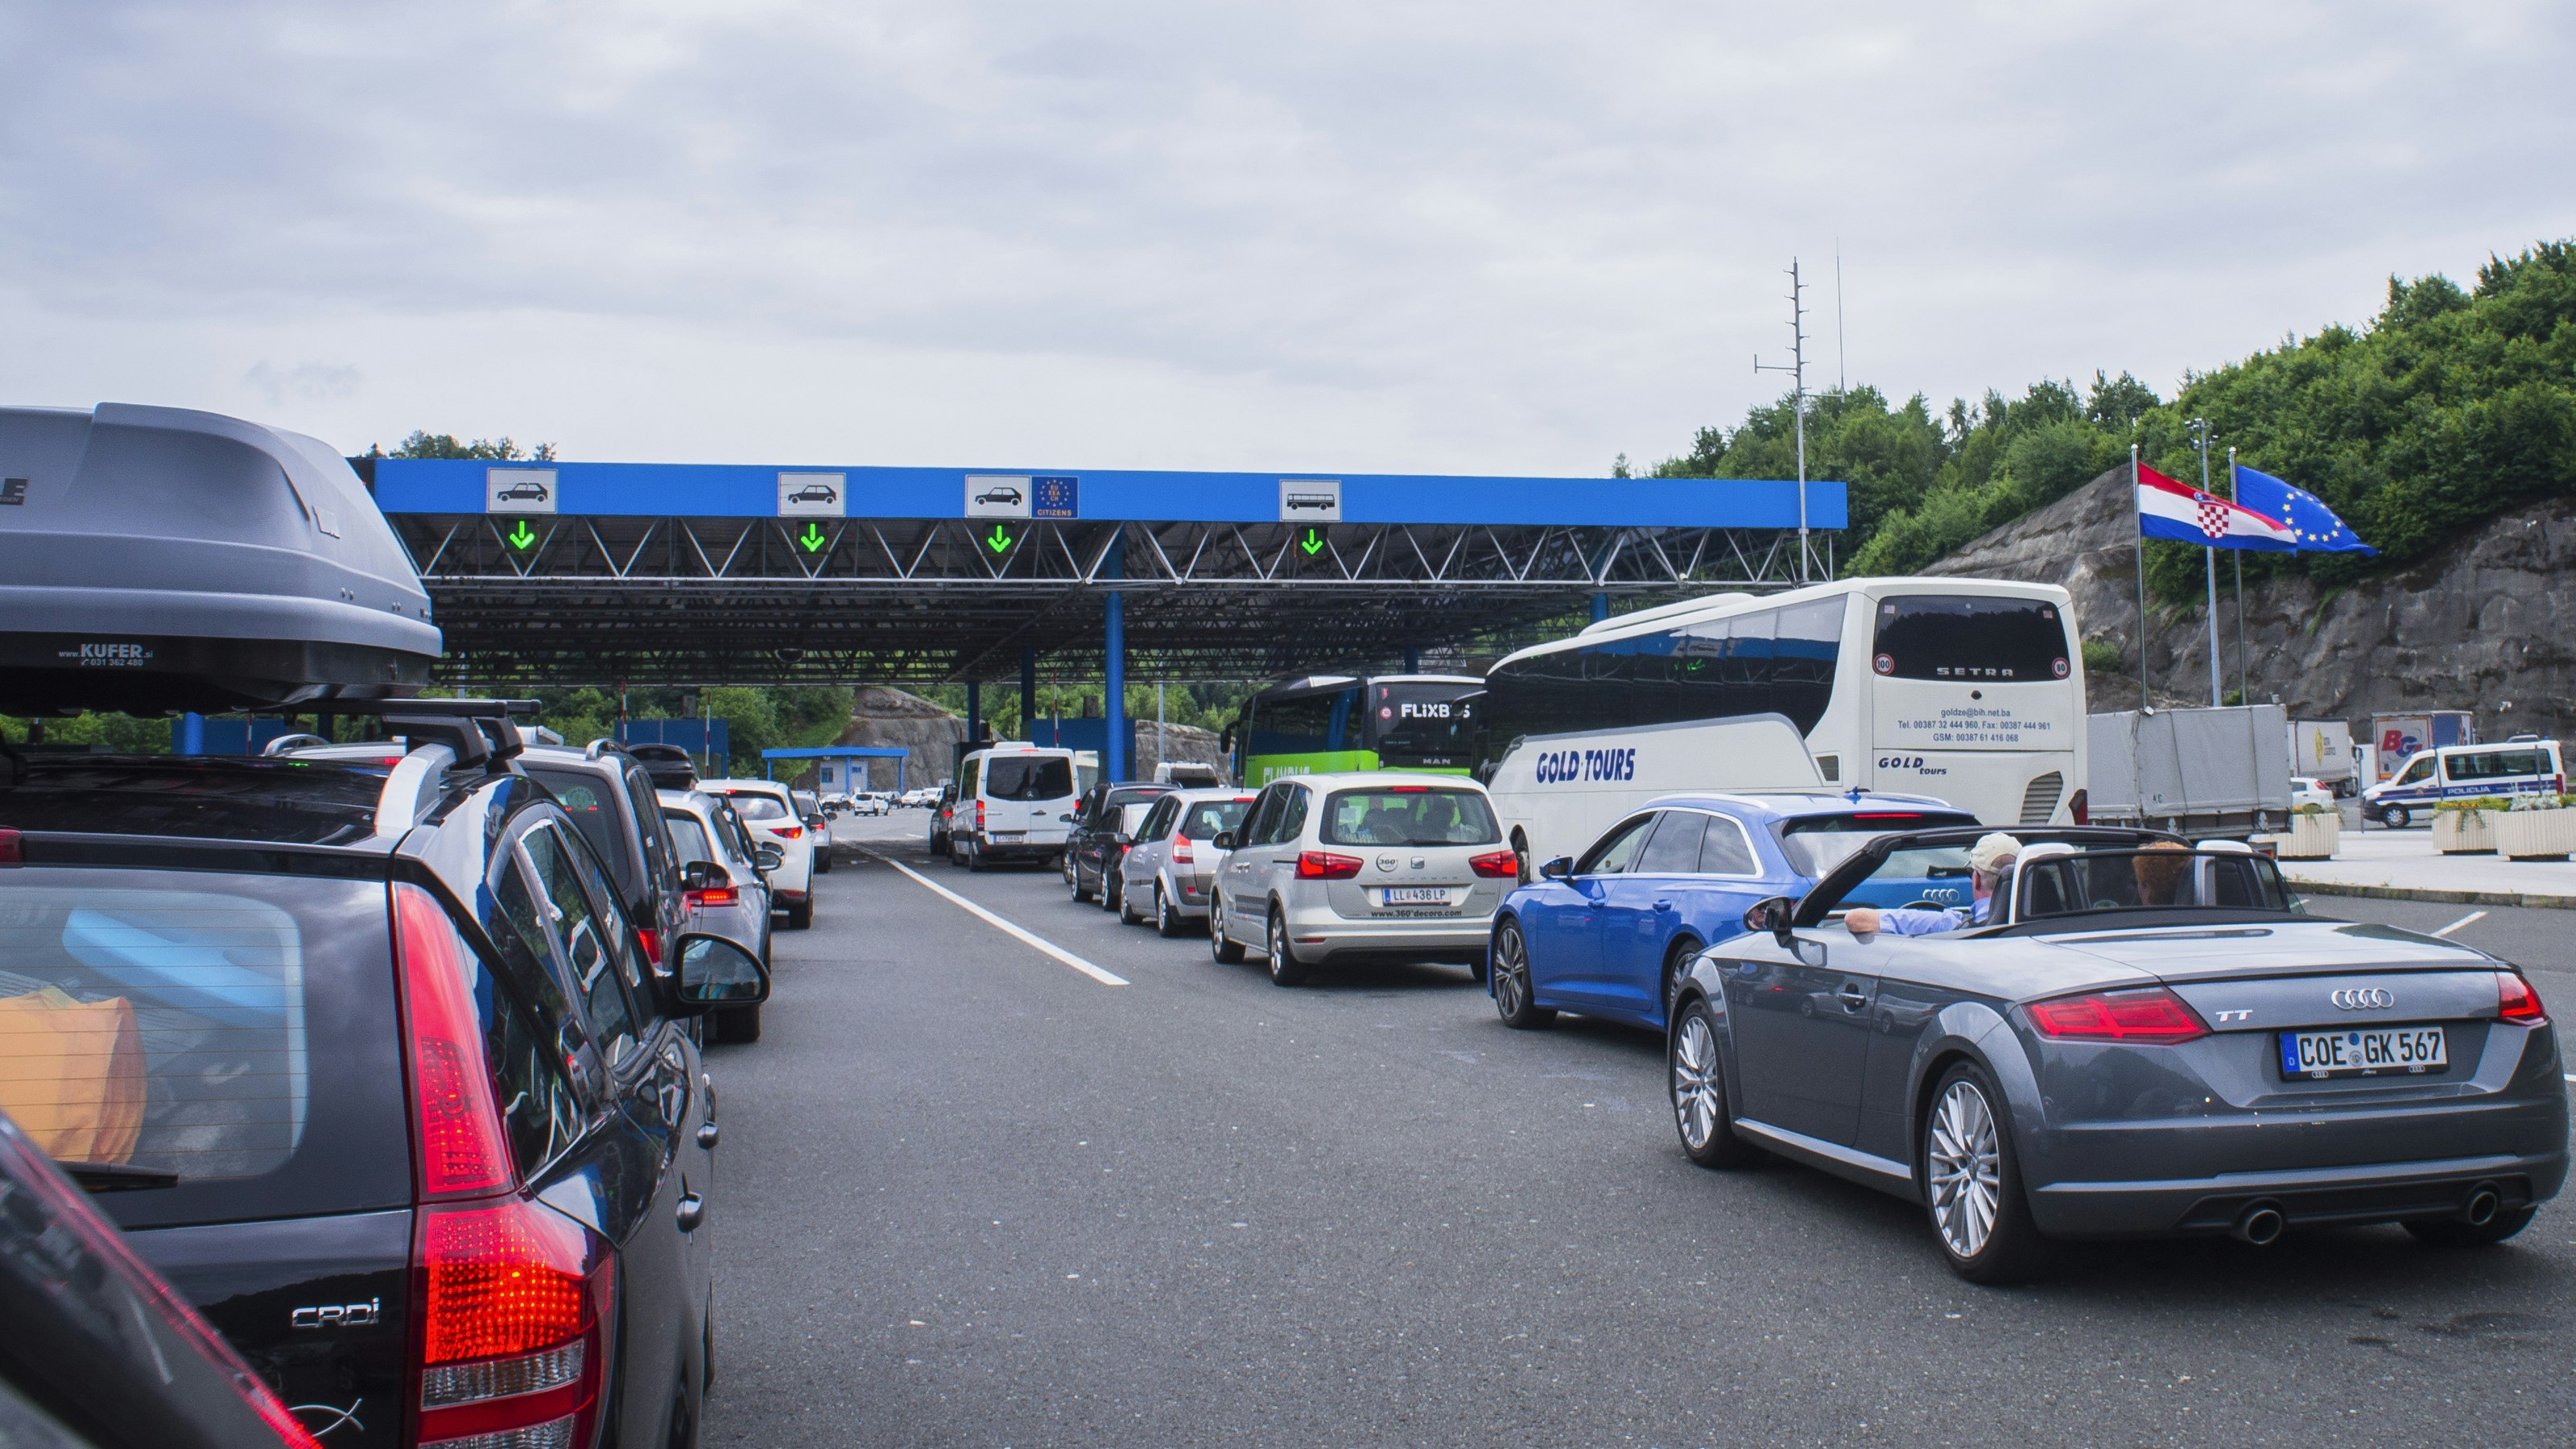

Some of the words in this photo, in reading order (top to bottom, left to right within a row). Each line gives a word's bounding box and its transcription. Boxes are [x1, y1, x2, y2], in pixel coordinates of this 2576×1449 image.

[91, 658, 106, 667] 031
[109, 658, 125, 667] 362
[1877, 660, 1890, 669] 100
[2056, 663, 2066, 672] 80
[1937, 667, 2013, 677] SETRA
[1401, 703, 1471, 718] FLiXBS
[1941, 708, 2011, 718] goldze@bih.net.ba
[1897, 720, 1911, 729] Tel.
[1913, 720, 1936, 729] 00387
[1938, 720, 1947, 729] 32
[1949, 720, 1963, 729] 444
[1982, 720, 1998, 729] Fax:
[2000, 721, 2021, 730] 00387
[2023, 722, 2036, 730] 444
[2037, 722, 2050, 730] 961
[1933, 733, 1954, 741] GSM:
[1956, 733, 1978, 741] 00387
[1979, 733, 1988, 741] 61
[1991, 733, 2004, 742] 416
[2005, 733, 2019, 742] 068
[1536, 751, 1580, 784] GOLD
[1583, 748, 1636, 782] TOURS
[1878, 757, 1924, 769] GOLD
[1919, 767, 1947, 775] tours
[2447, 786, 2491, 795] POLICIJA
[1393, 890, 1407, 901] LL
[1413, 889, 1432, 901] 436
[1434, 889, 1446, 900] LP
[2215, 1009, 2253, 1022] TT
[2299, 1035, 2347, 1067] COE
[2363, 1034, 2395, 1063] GK
[2398, 1031, 2441, 1061] 567
[292, 1297, 379, 1328] CRDi
